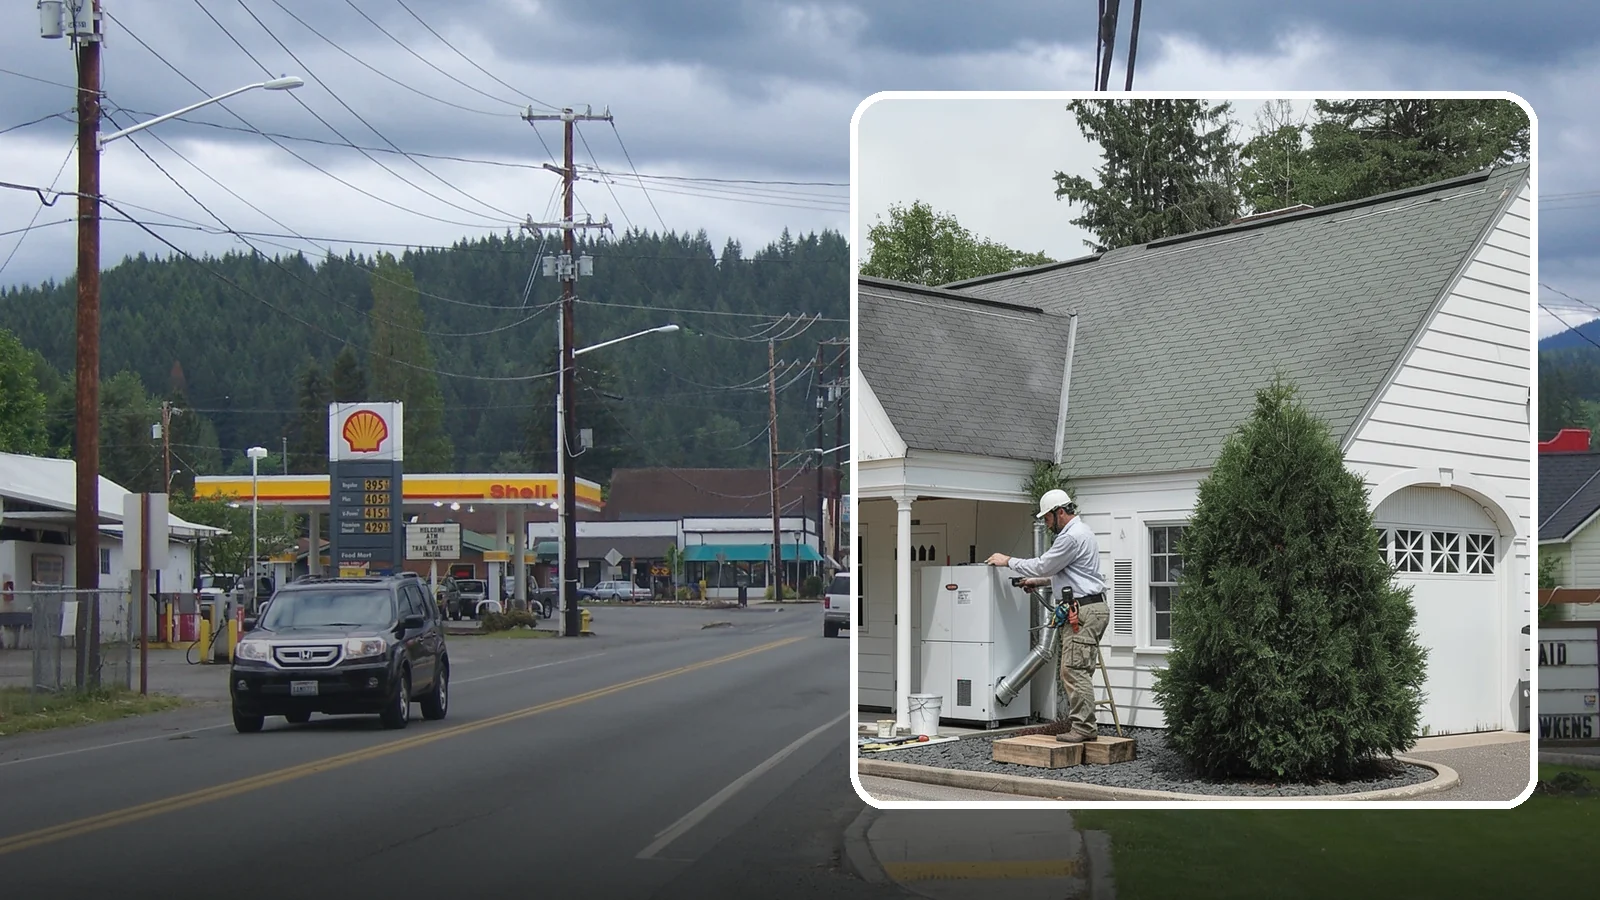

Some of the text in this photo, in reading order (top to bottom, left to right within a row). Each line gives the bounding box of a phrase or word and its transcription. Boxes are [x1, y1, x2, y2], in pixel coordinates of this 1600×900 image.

[366, 479, 383, 490] 395
[490, 484, 547, 499] Shell
[366, 494, 383, 504] 405
[366, 508, 383, 518] 415
[366, 522, 383, 532] 429
[1538, 642, 1566, 666] AID
